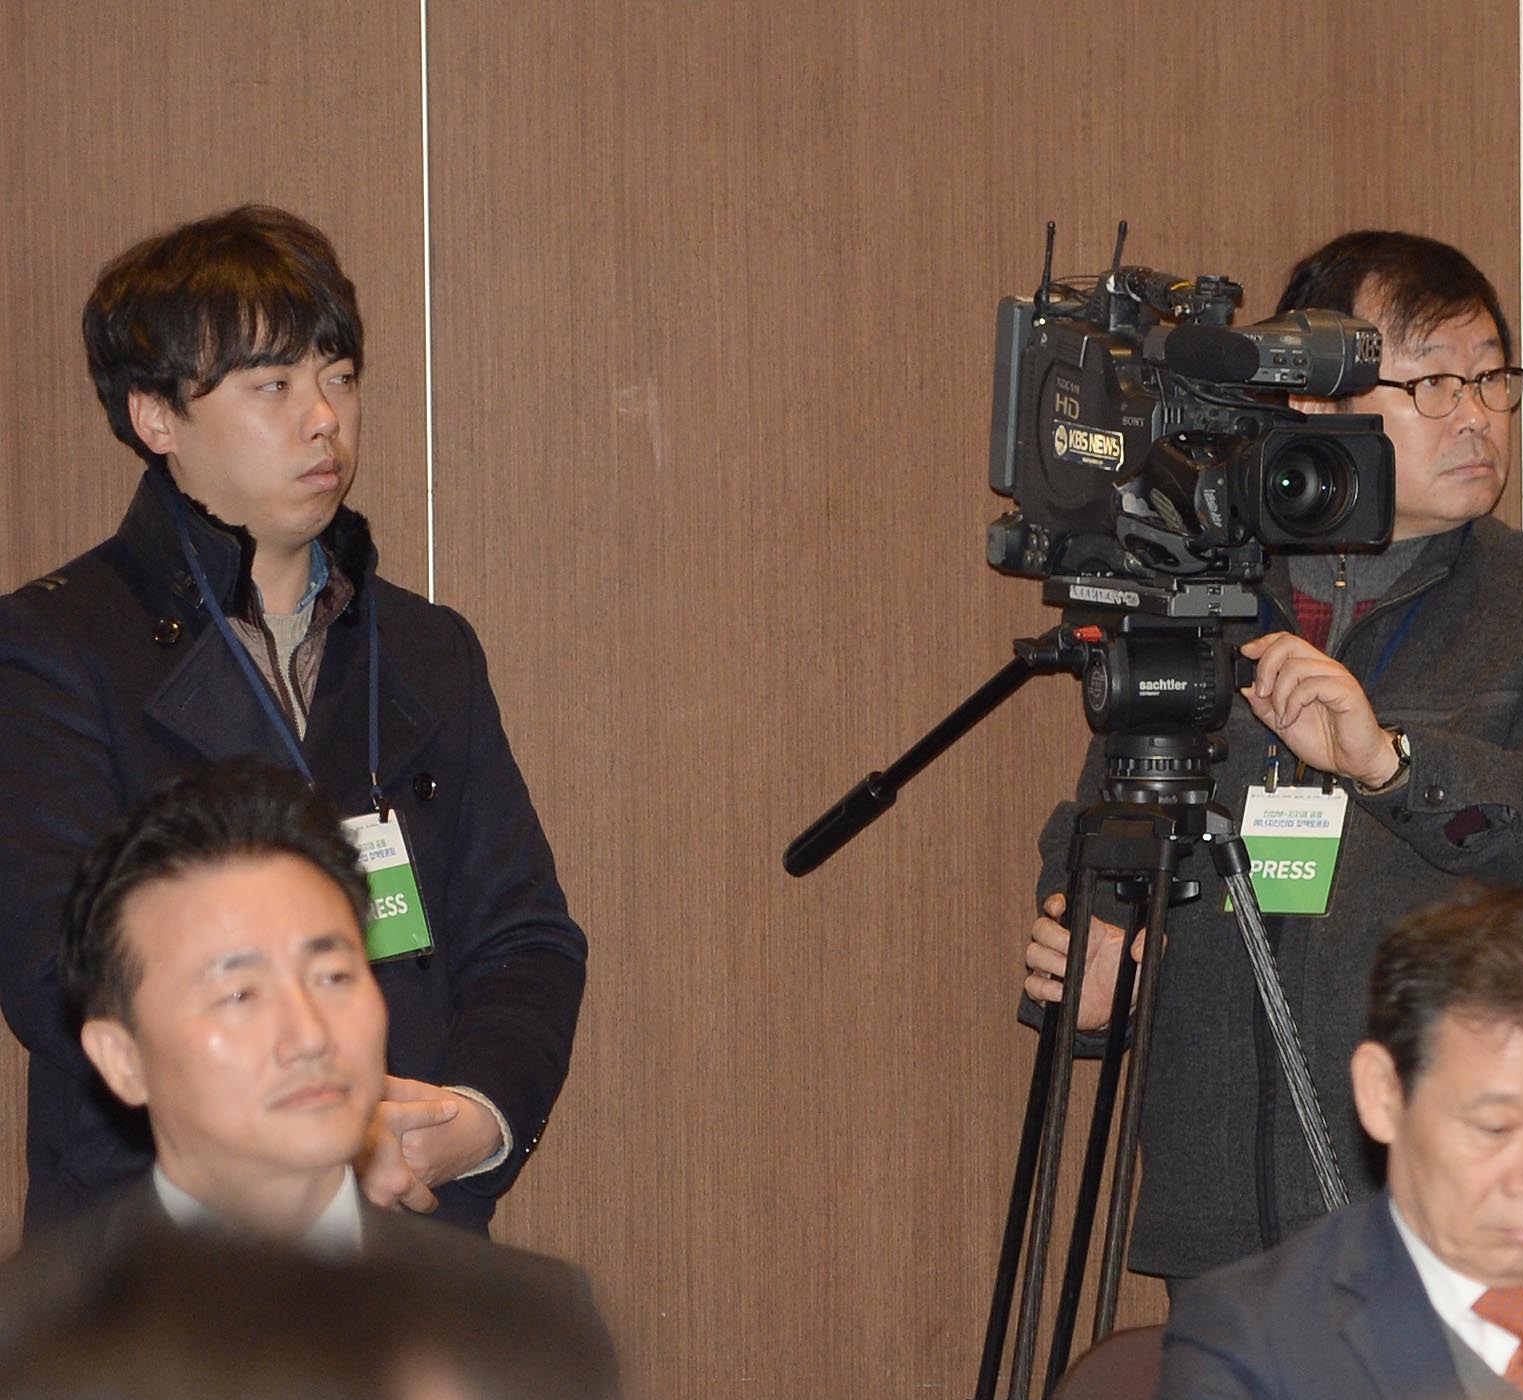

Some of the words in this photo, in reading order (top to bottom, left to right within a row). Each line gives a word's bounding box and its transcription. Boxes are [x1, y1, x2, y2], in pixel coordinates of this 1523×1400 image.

[1055, 393, 1080, 420] HD
[1069, 429, 1089, 452] KBS
[1089, 432, 1121, 457] NEWS
[1139, 679, 1188, 691] sachtler
[1249, 859, 1318, 880] PRESS
[368, 892, 409, 921] ESS
